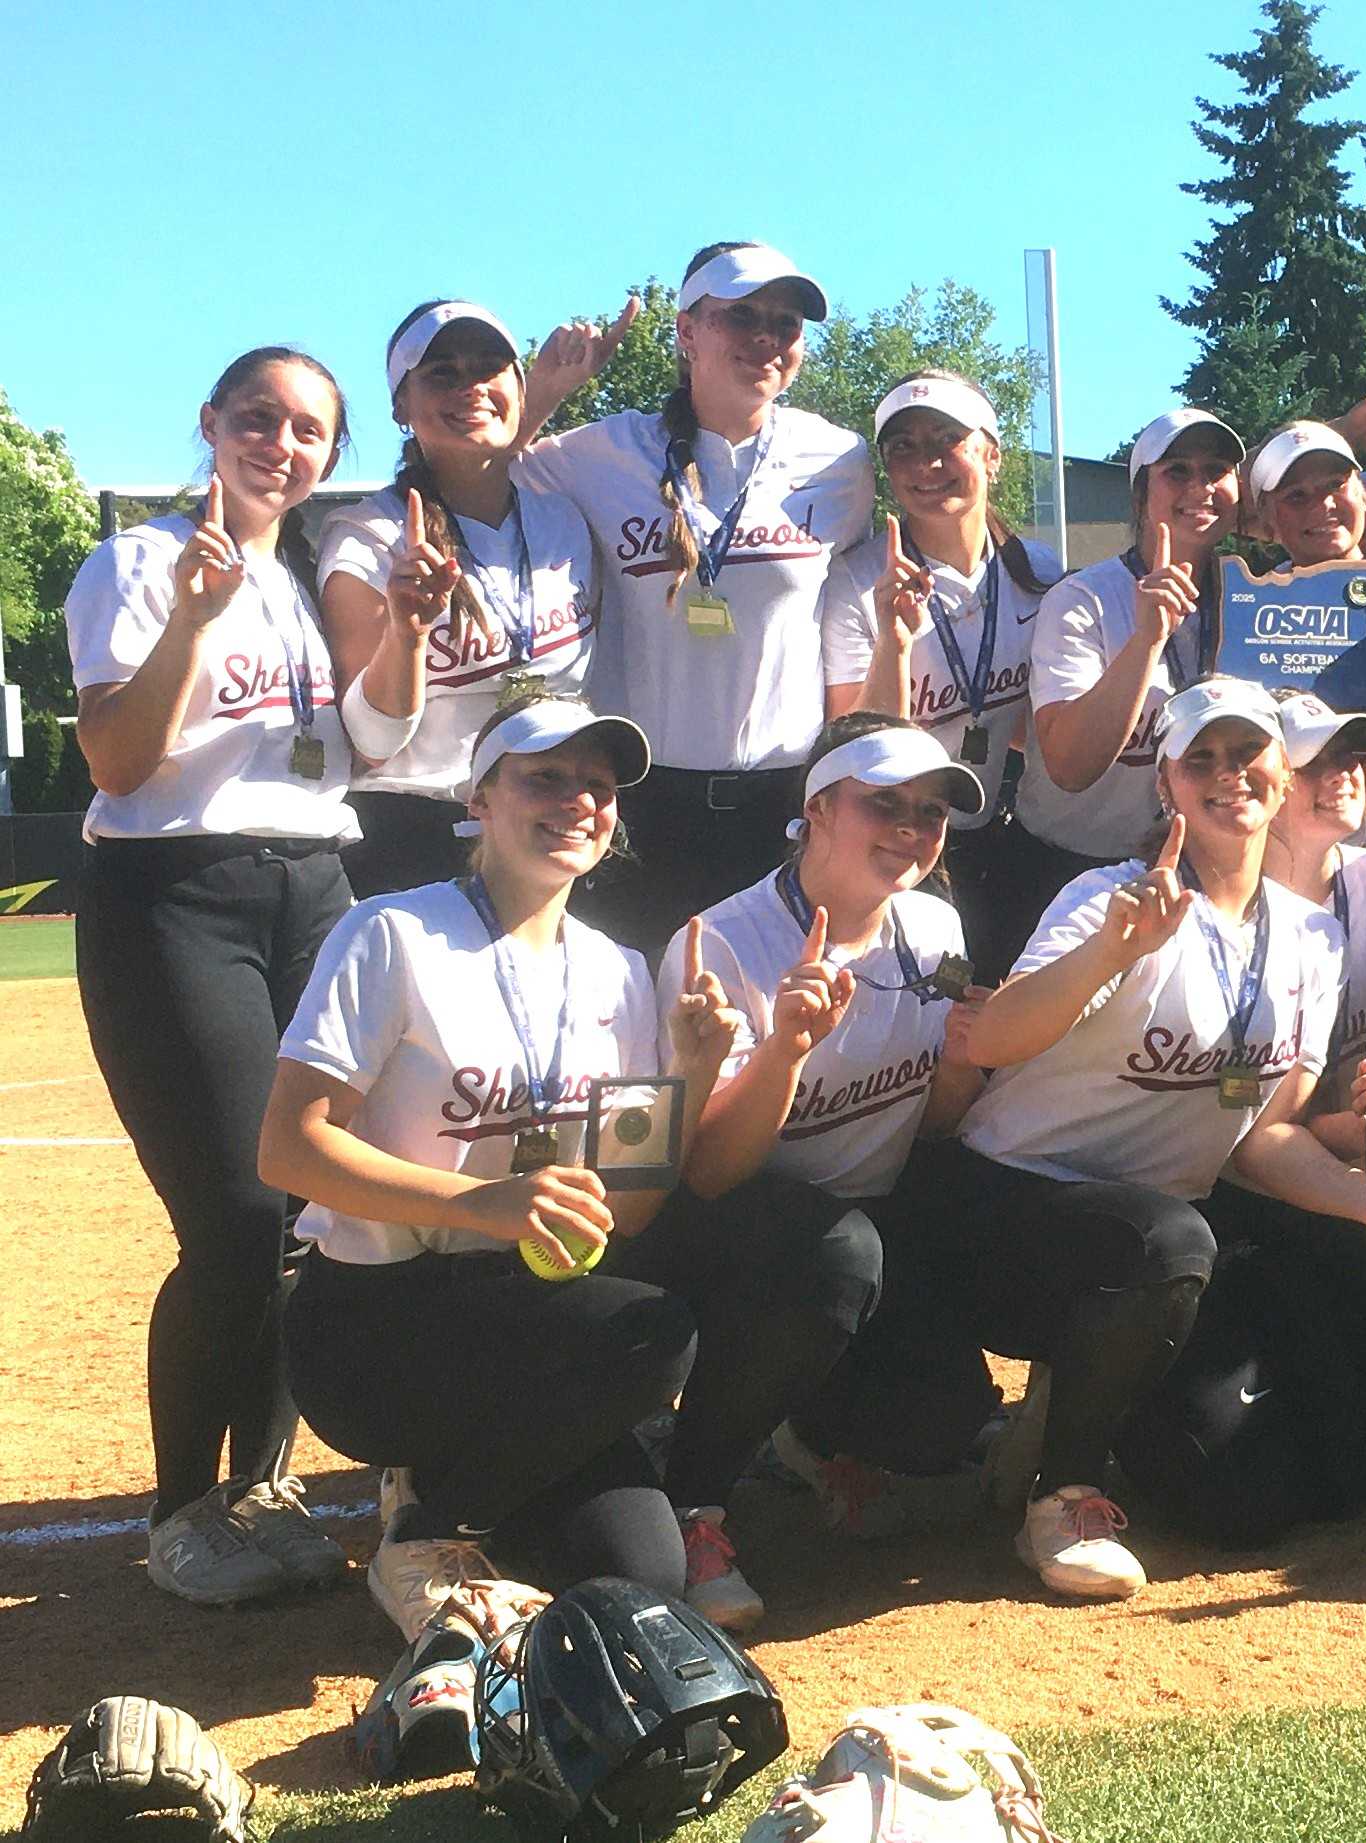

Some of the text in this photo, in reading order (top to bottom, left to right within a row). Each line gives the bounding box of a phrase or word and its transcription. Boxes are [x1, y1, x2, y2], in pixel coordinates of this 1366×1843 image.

[1254, 604, 1349, 640] OSAA
[1259, 652, 1339, 666] 6A SOFTBA
